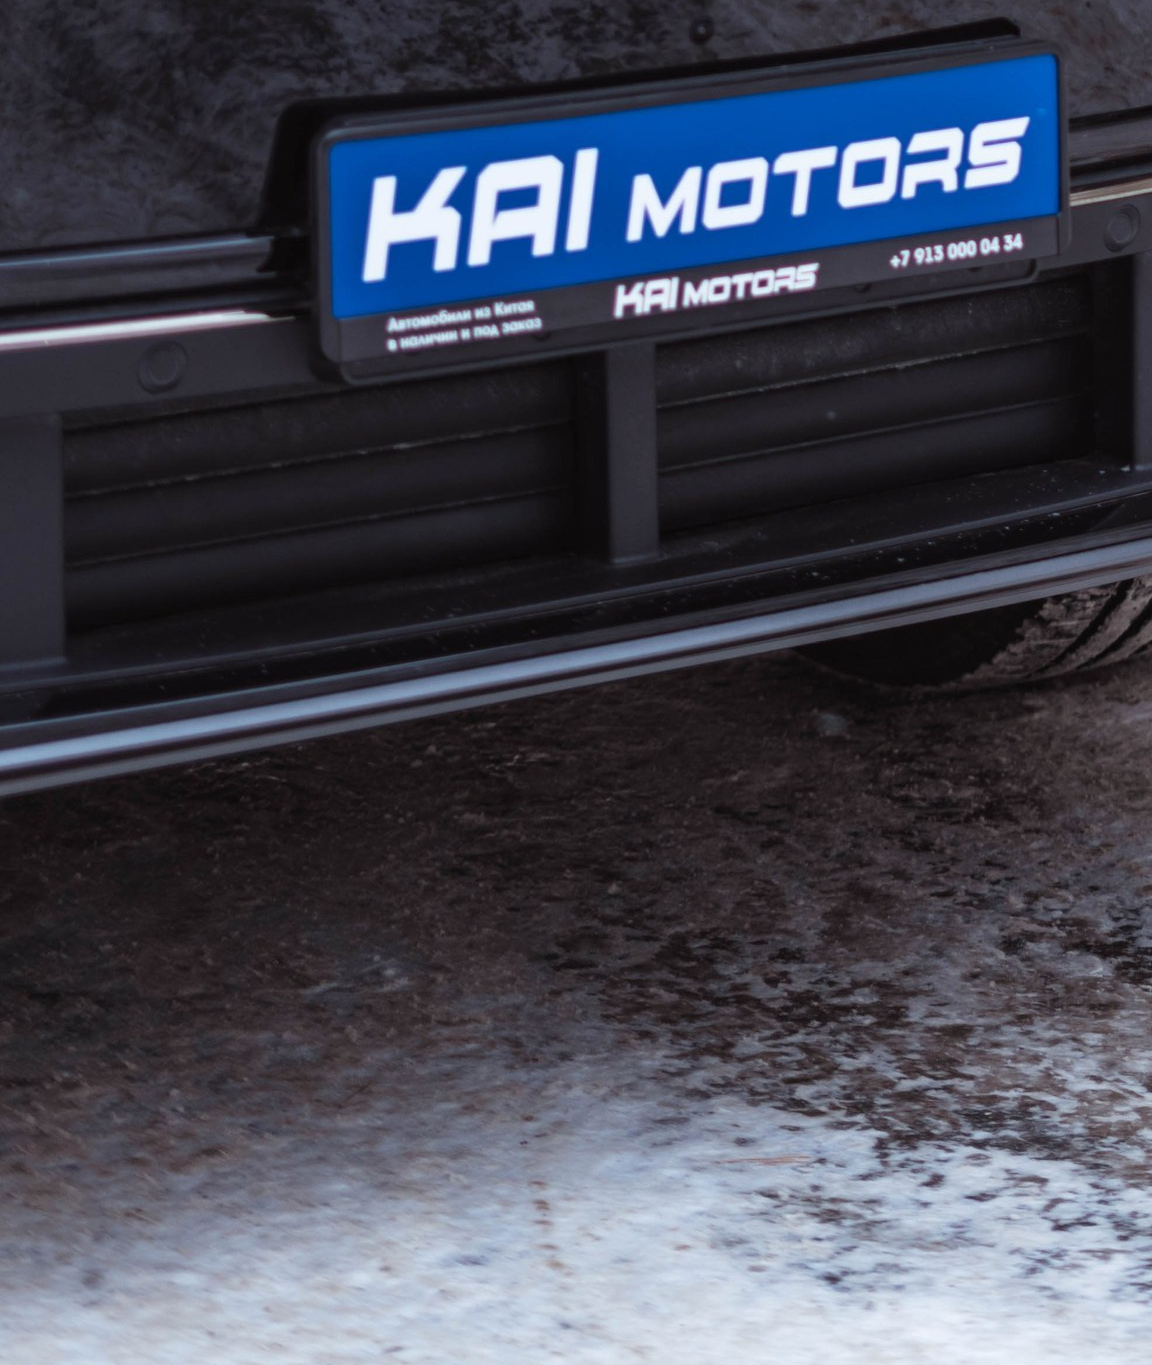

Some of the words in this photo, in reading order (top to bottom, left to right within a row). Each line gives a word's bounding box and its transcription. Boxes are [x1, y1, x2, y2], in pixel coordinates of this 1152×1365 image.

[362, 147, 599, 283] KAI
[626, 116, 1030, 243] MOTORS
[889, 249, 911, 268] +7
[913, 244, 945, 265] 913
[946, 239, 978, 261] 000
[979, 236, 1001, 256] 04
[1002, 232, 1024, 253] 34
[613, 276, 680, 319] KAI
[681, 262, 820, 308] MOTORS
[386, 309, 473, 333] Автомобили
[474, 306, 492, 320] из
[493, 300, 536, 317] Китая
[386, 338, 398, 352] в
[399, 329, 459, 350] наличии
[459, 328, 472, 341] и
[472, 324, 500, 339] под
[501, 317, 544, 335] заказ
